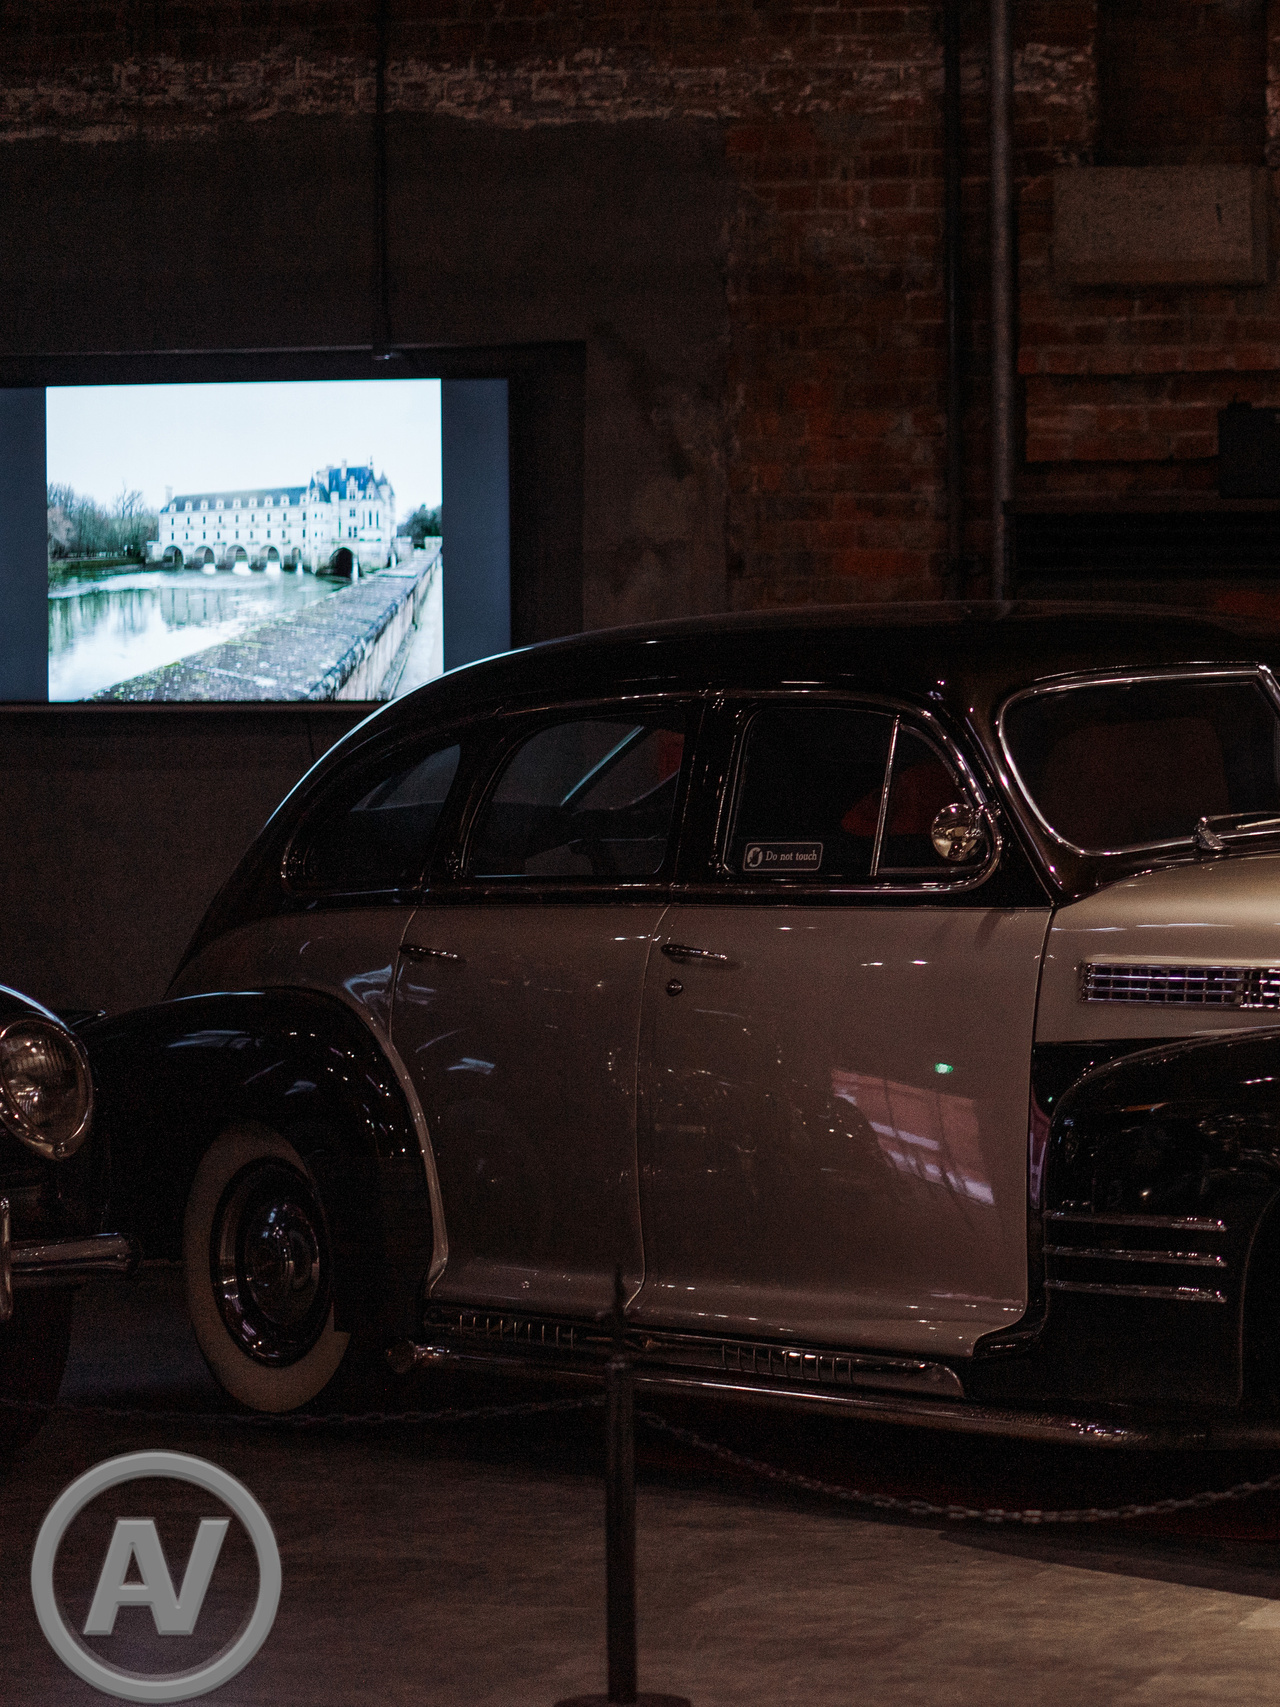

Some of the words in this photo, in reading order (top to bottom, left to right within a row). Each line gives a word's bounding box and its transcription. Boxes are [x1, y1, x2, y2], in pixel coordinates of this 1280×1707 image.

[765, 850, 778, 861] Do
[780, 851, 793, 861] not
[795, 849, 817, 861] touch
